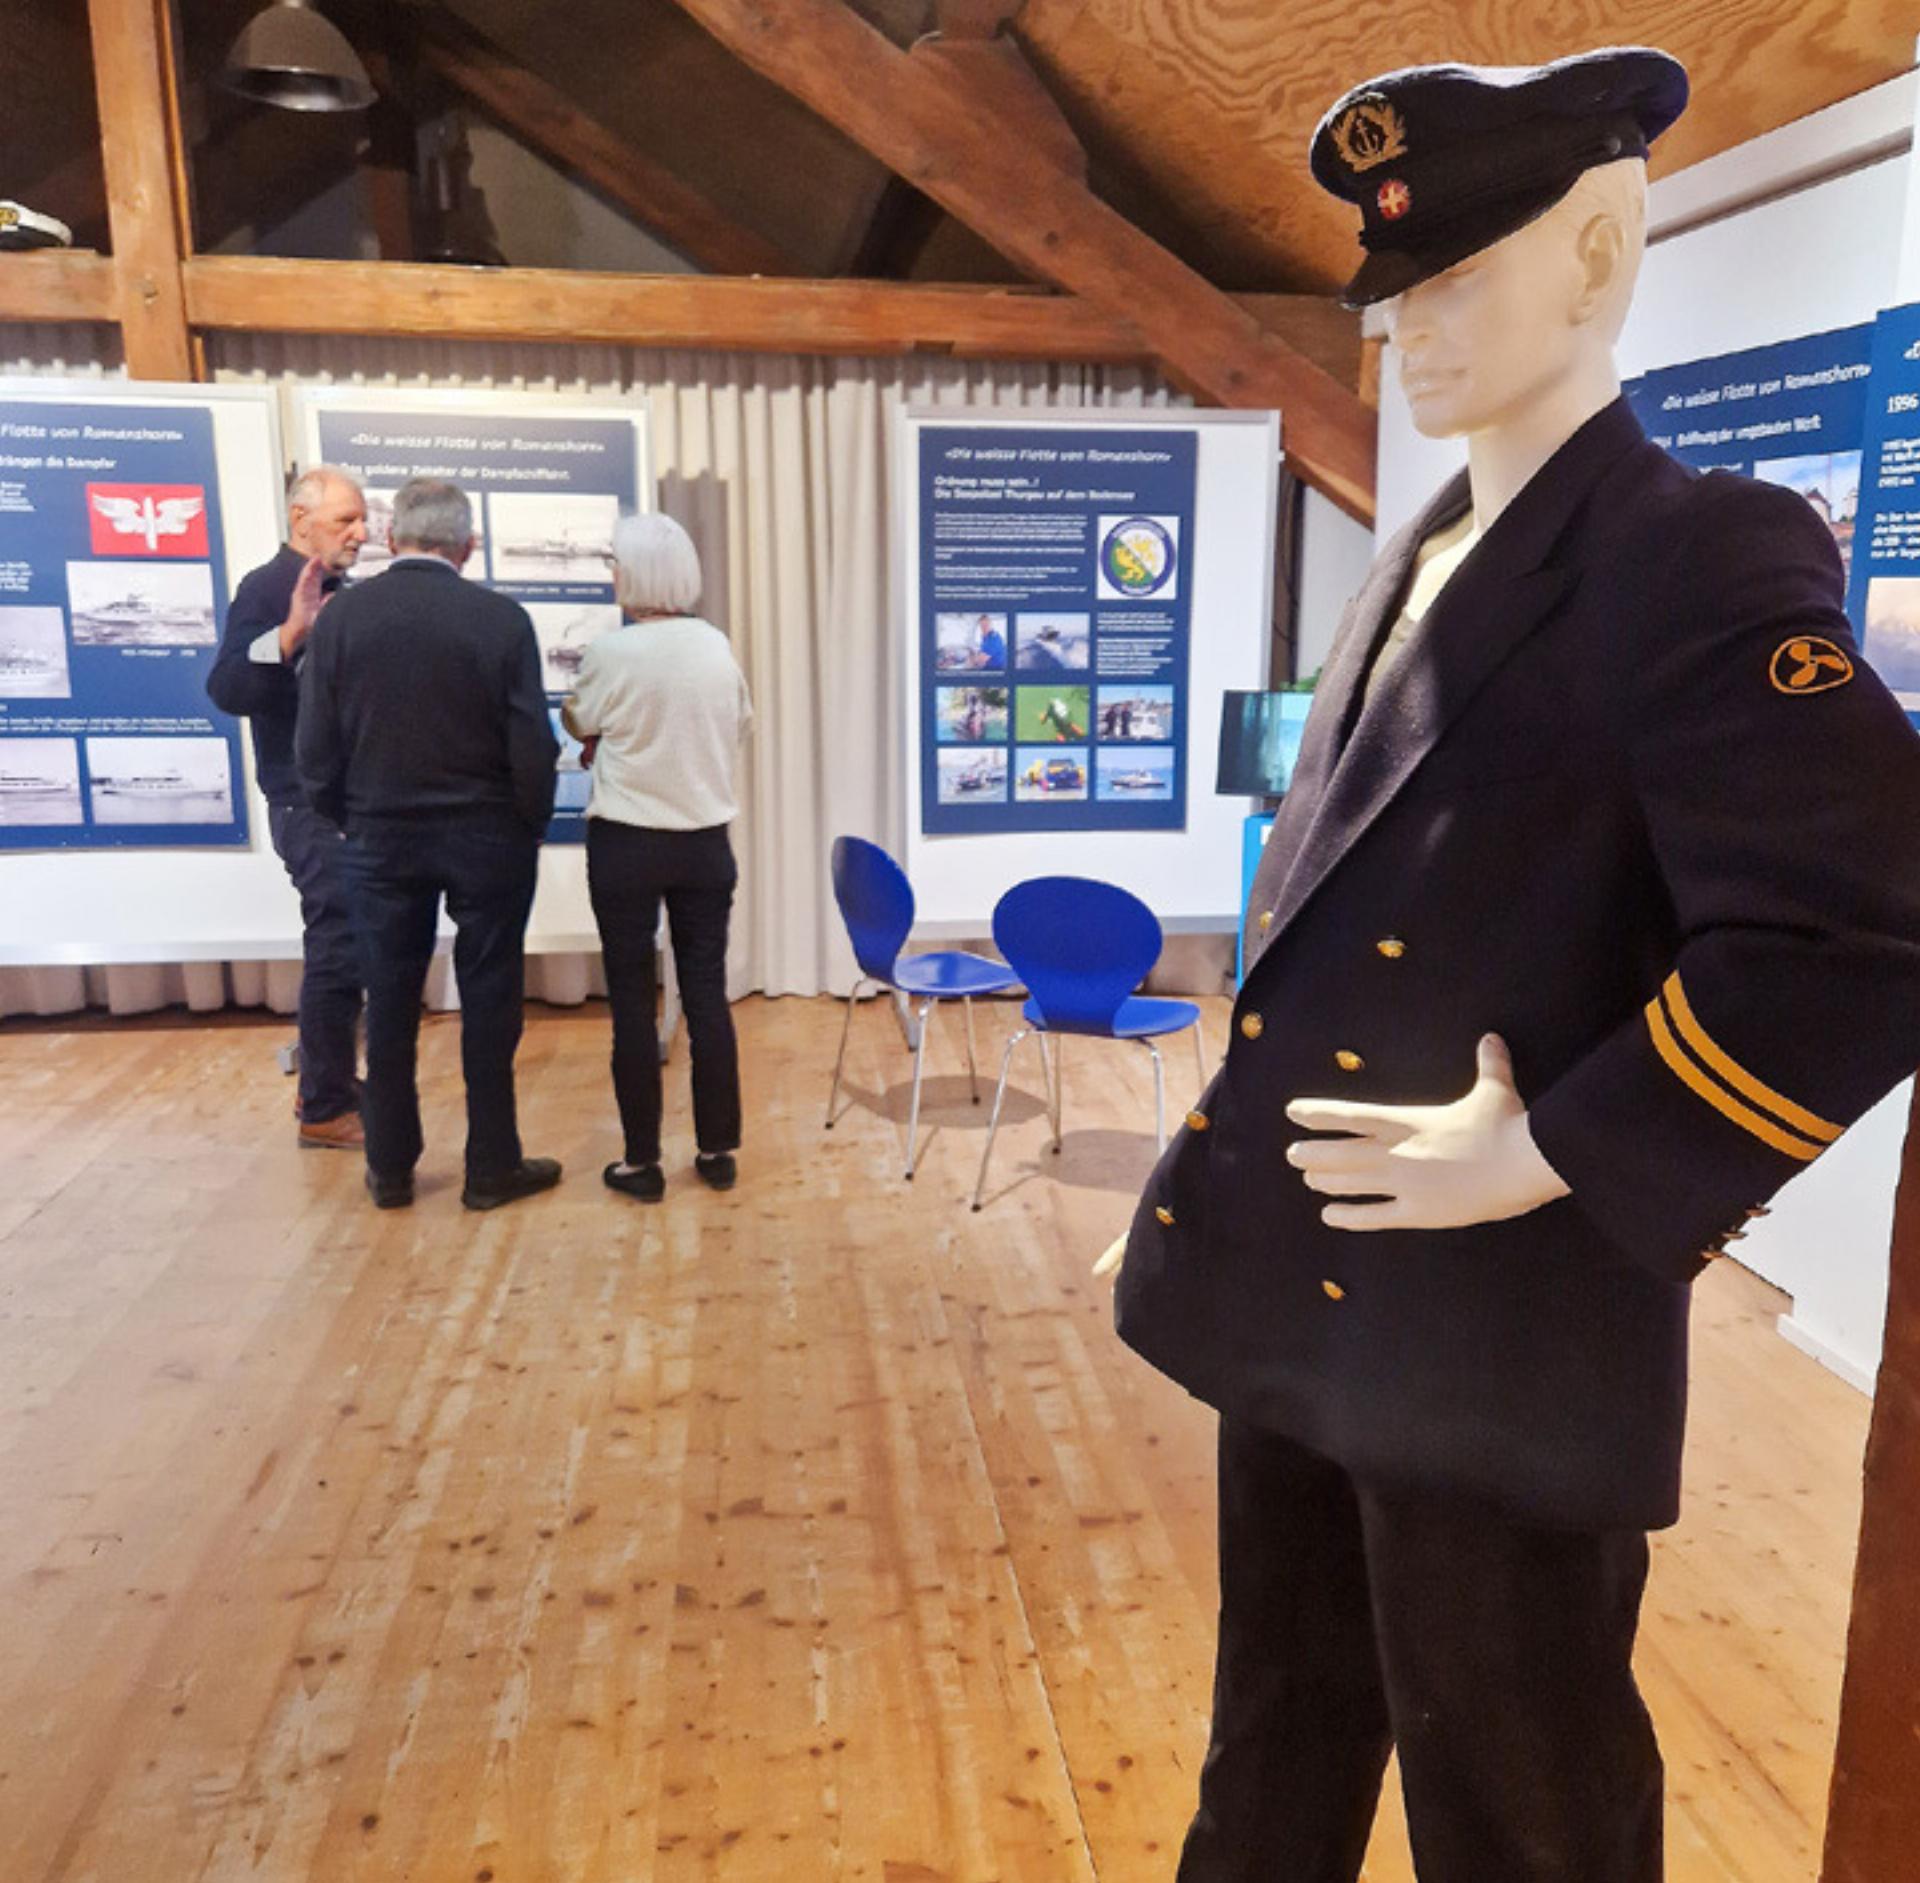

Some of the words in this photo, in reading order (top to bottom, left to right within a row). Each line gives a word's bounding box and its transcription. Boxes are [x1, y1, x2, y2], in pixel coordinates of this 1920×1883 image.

[1721, 383, 1757, 401] Flotte
[1759, 379, 1781, 395] von
[0, 421, 46, 438] Flotte
[50, 426, 79, 438] von
[83, 425, 183, 441] Romanshorn»
[384, 434, 432, 448] weisse
[433, 436, 477, 450] Flotte
[481, 440, 506, 451] von
[511, 439, 605, 454] Romanshorn»
[975, 448, 1016, 461] weisse
[1020, 449, 1057, 462] Flotte
[1060, 451, 1084, 462] von
[66, 456, 117, 470] Dampfer
[364, 464, 408, 477] goldene
[460, 467, 479, 479] der
[934, 476, 978, 489] Ordnung
[1004, 489, 1044, 502] Thurgau
[1046, 489, 1065, 501] auf
[1088, 490, 1136, 502] Bodensee
